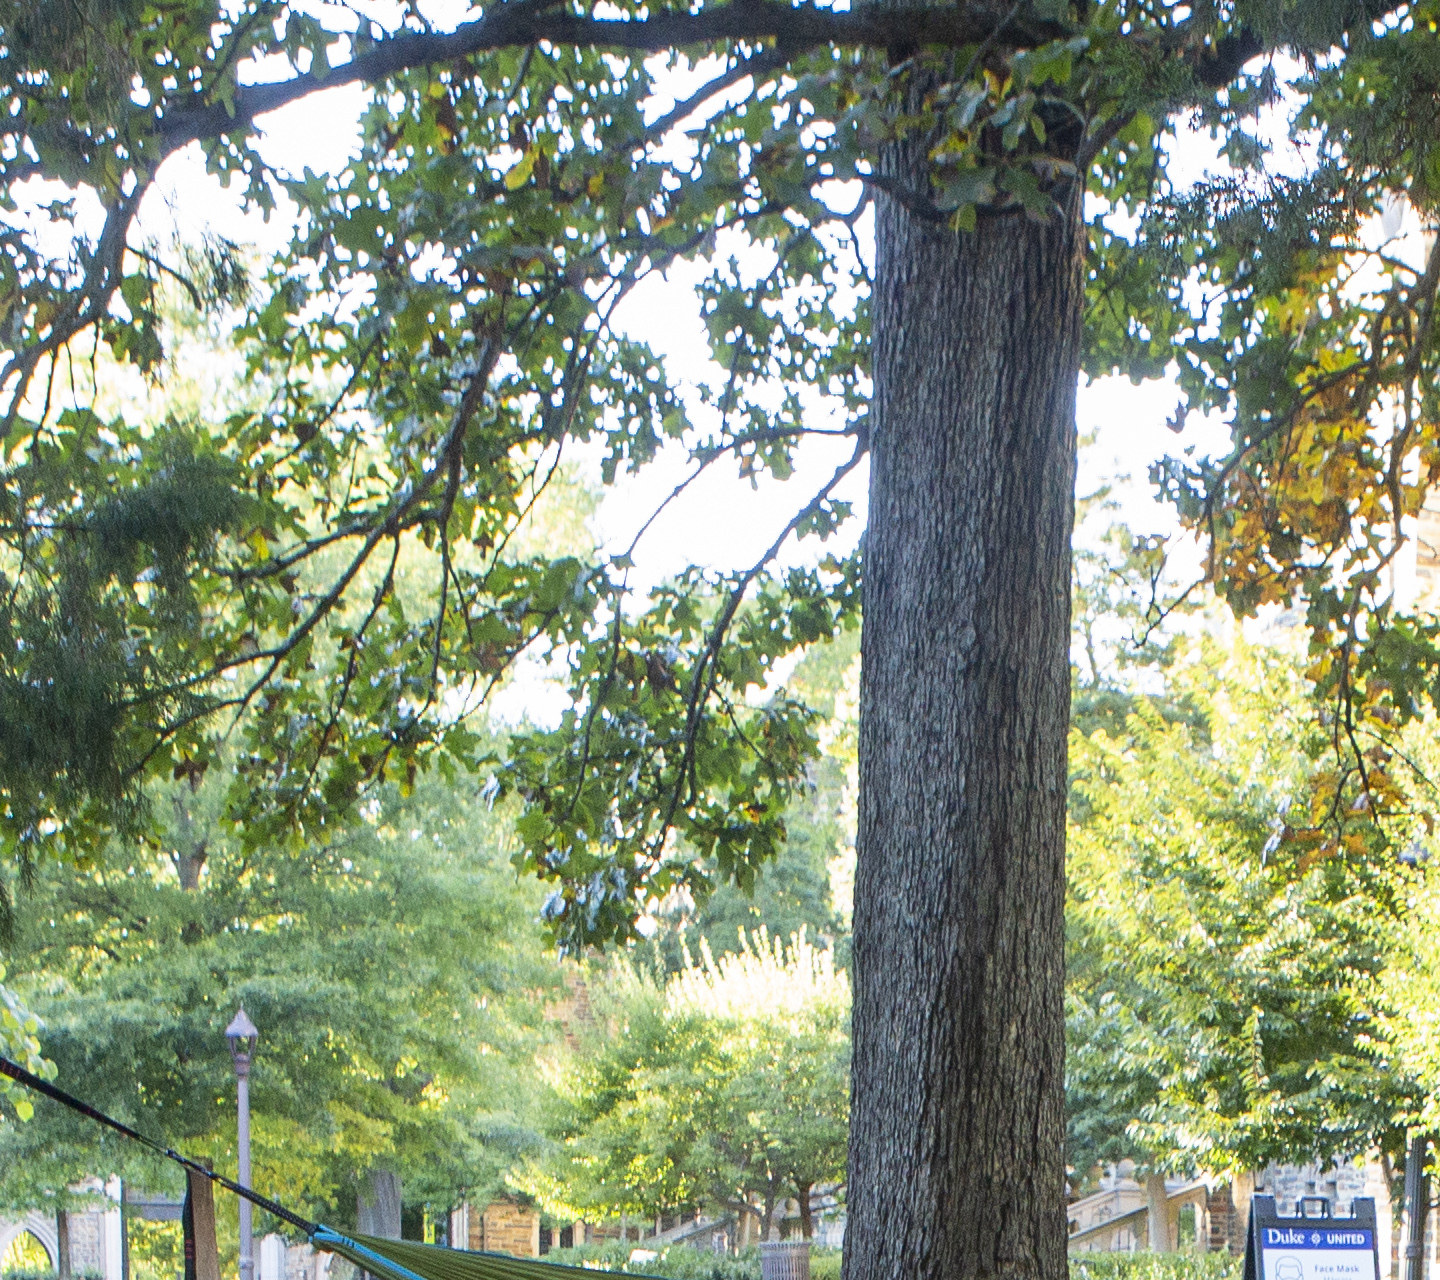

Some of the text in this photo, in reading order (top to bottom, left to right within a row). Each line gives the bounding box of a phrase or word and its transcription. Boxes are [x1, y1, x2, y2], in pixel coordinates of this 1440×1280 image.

[1268, 1228, 1365, 1245] Duke UNITED
[1314, 1264, 1360, 1273] Face Mask
